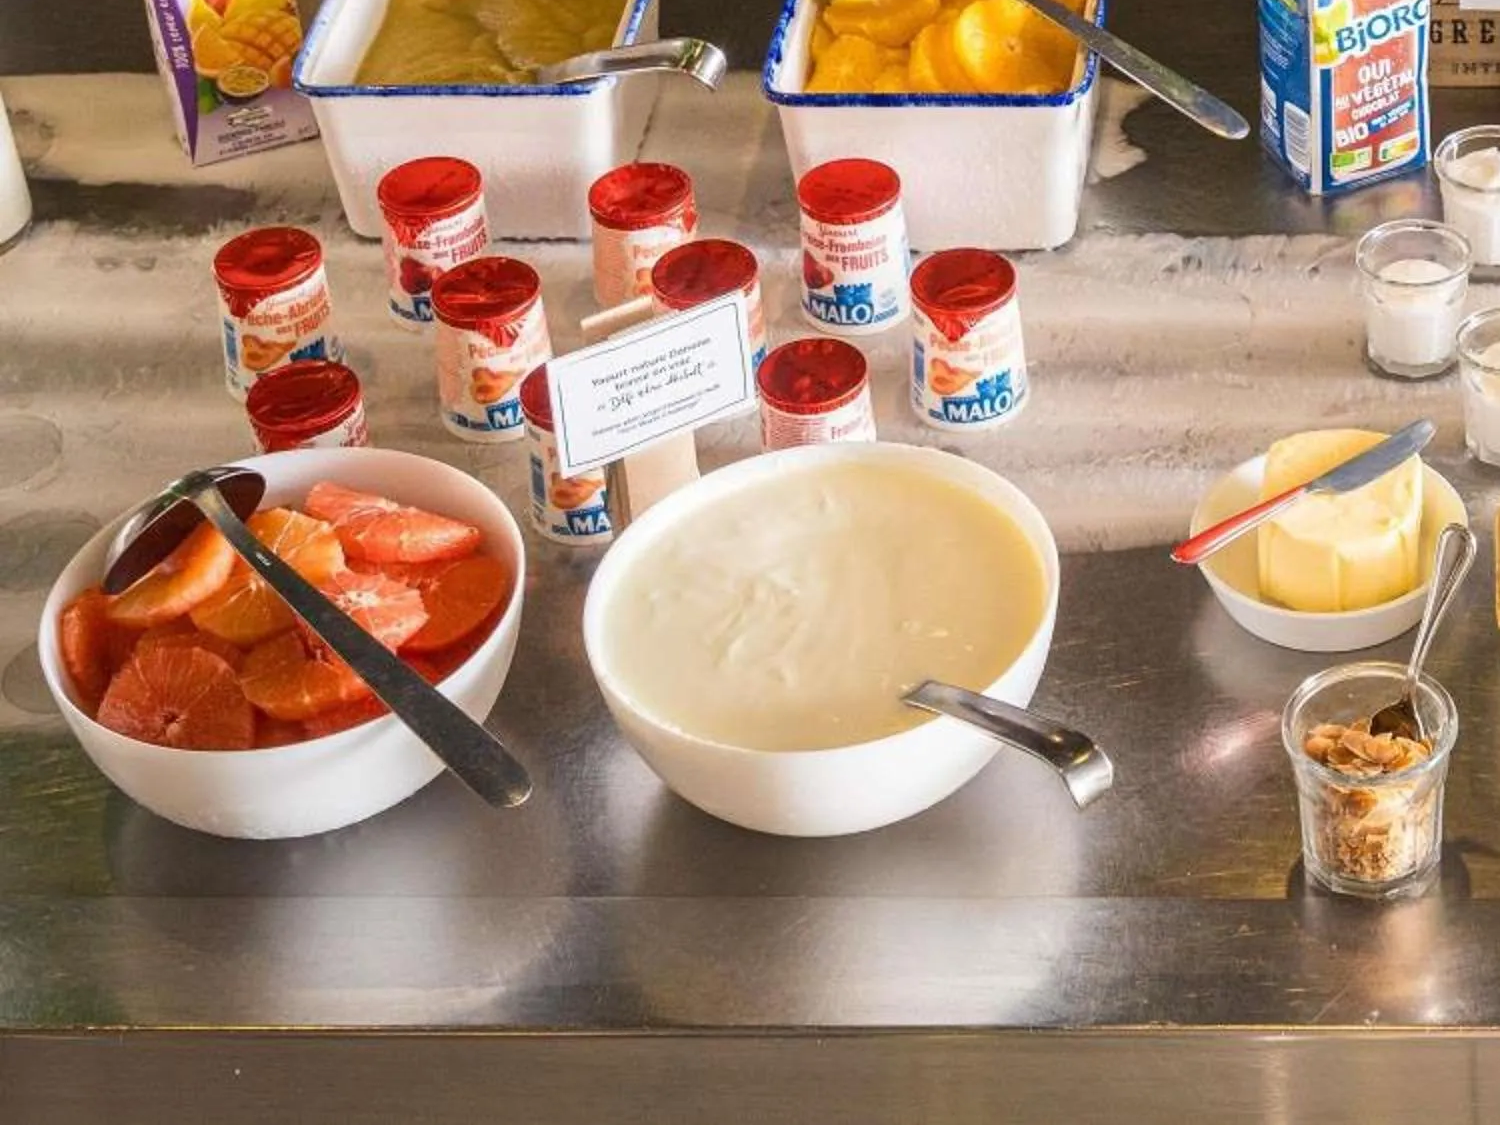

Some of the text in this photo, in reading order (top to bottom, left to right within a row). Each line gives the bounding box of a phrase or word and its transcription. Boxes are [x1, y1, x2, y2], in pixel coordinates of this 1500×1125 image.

[1357, 59, 1392, 81] OUI
[1336, 123, 1370, 148] BIO
[841, 247, 890, 272] FRUITS
[811, 298, 872, 325] MALO
[947, 390, 1012, 421] MALO
